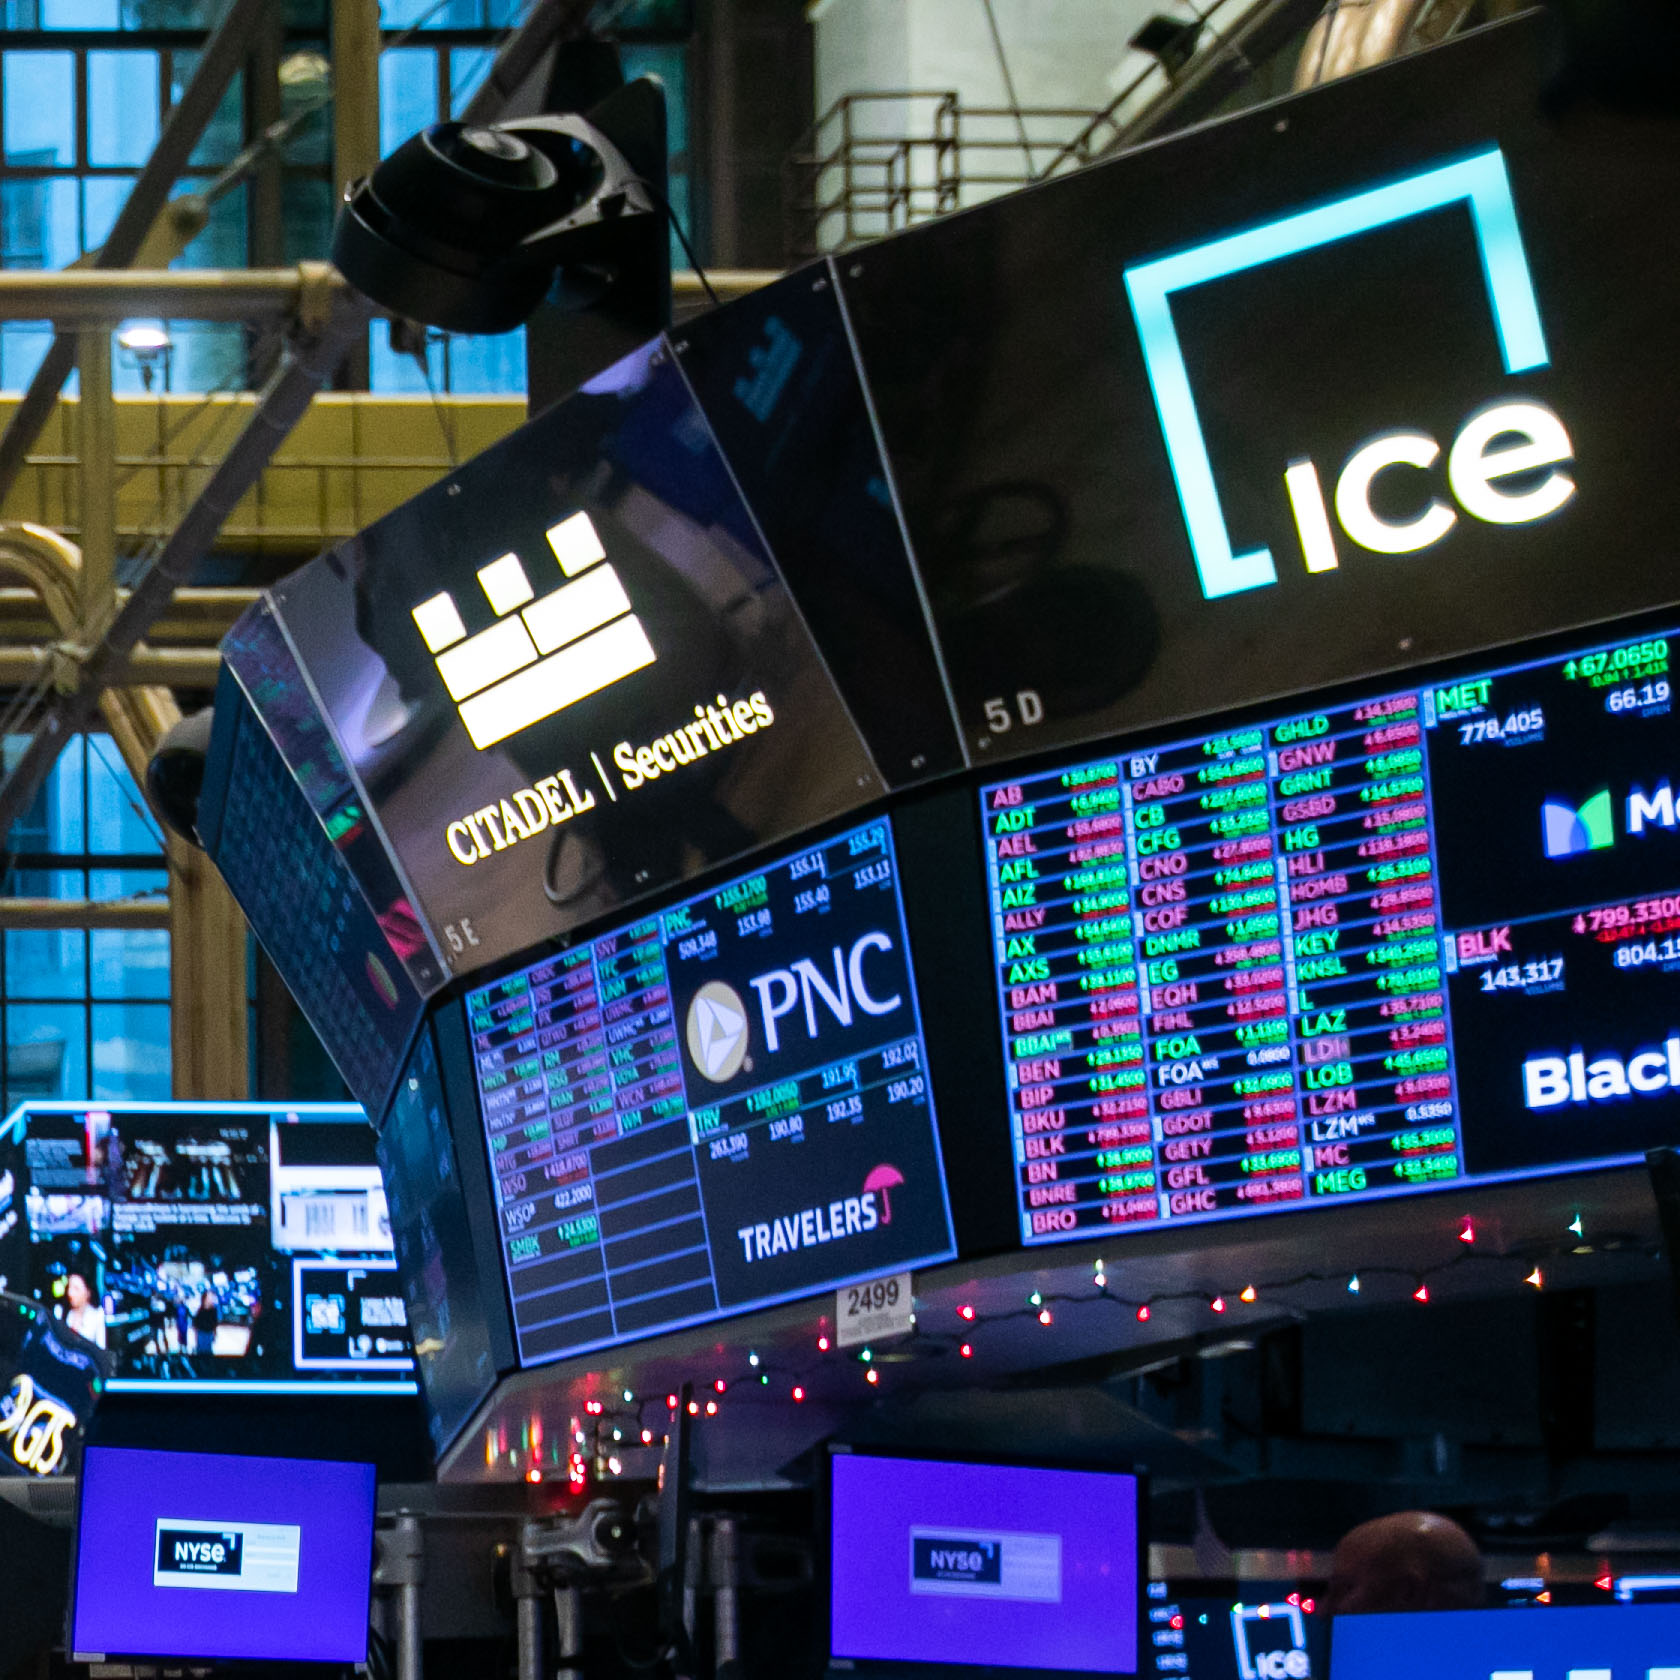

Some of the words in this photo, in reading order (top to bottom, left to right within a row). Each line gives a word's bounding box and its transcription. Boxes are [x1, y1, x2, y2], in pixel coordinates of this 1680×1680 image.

[1579, 638, 1669, 678] 67.0650
[1436, 678, 1493, 714] MET
[1608, 680, 1671, 713] 66.19
[1458, 707, 1545, 746] 778,405
[1129, 753, 1160, 778] BY
[1278, 740, 1338, 773] GNW
[445, 767, 597, 866] CITADEL
[613, 690, 775, 791] Securities
[995, 805, 1037, 835] ADT
[1137, 827, 1183, 855] CFG
[1294, 928, 1342, 958] KEY
[1457, 926, 1513, 959] BLK
[749, 930, 902, 1054] PNC
[1480, 956, 1565, 992] 143,317
[1315, 1167, 1368, 1193] MEG
[737, 1191, 879, 1264] TRAVELERS
[847, 1278, 900, 1318] 2499
[11, 1400, 77, 1475] GTS
